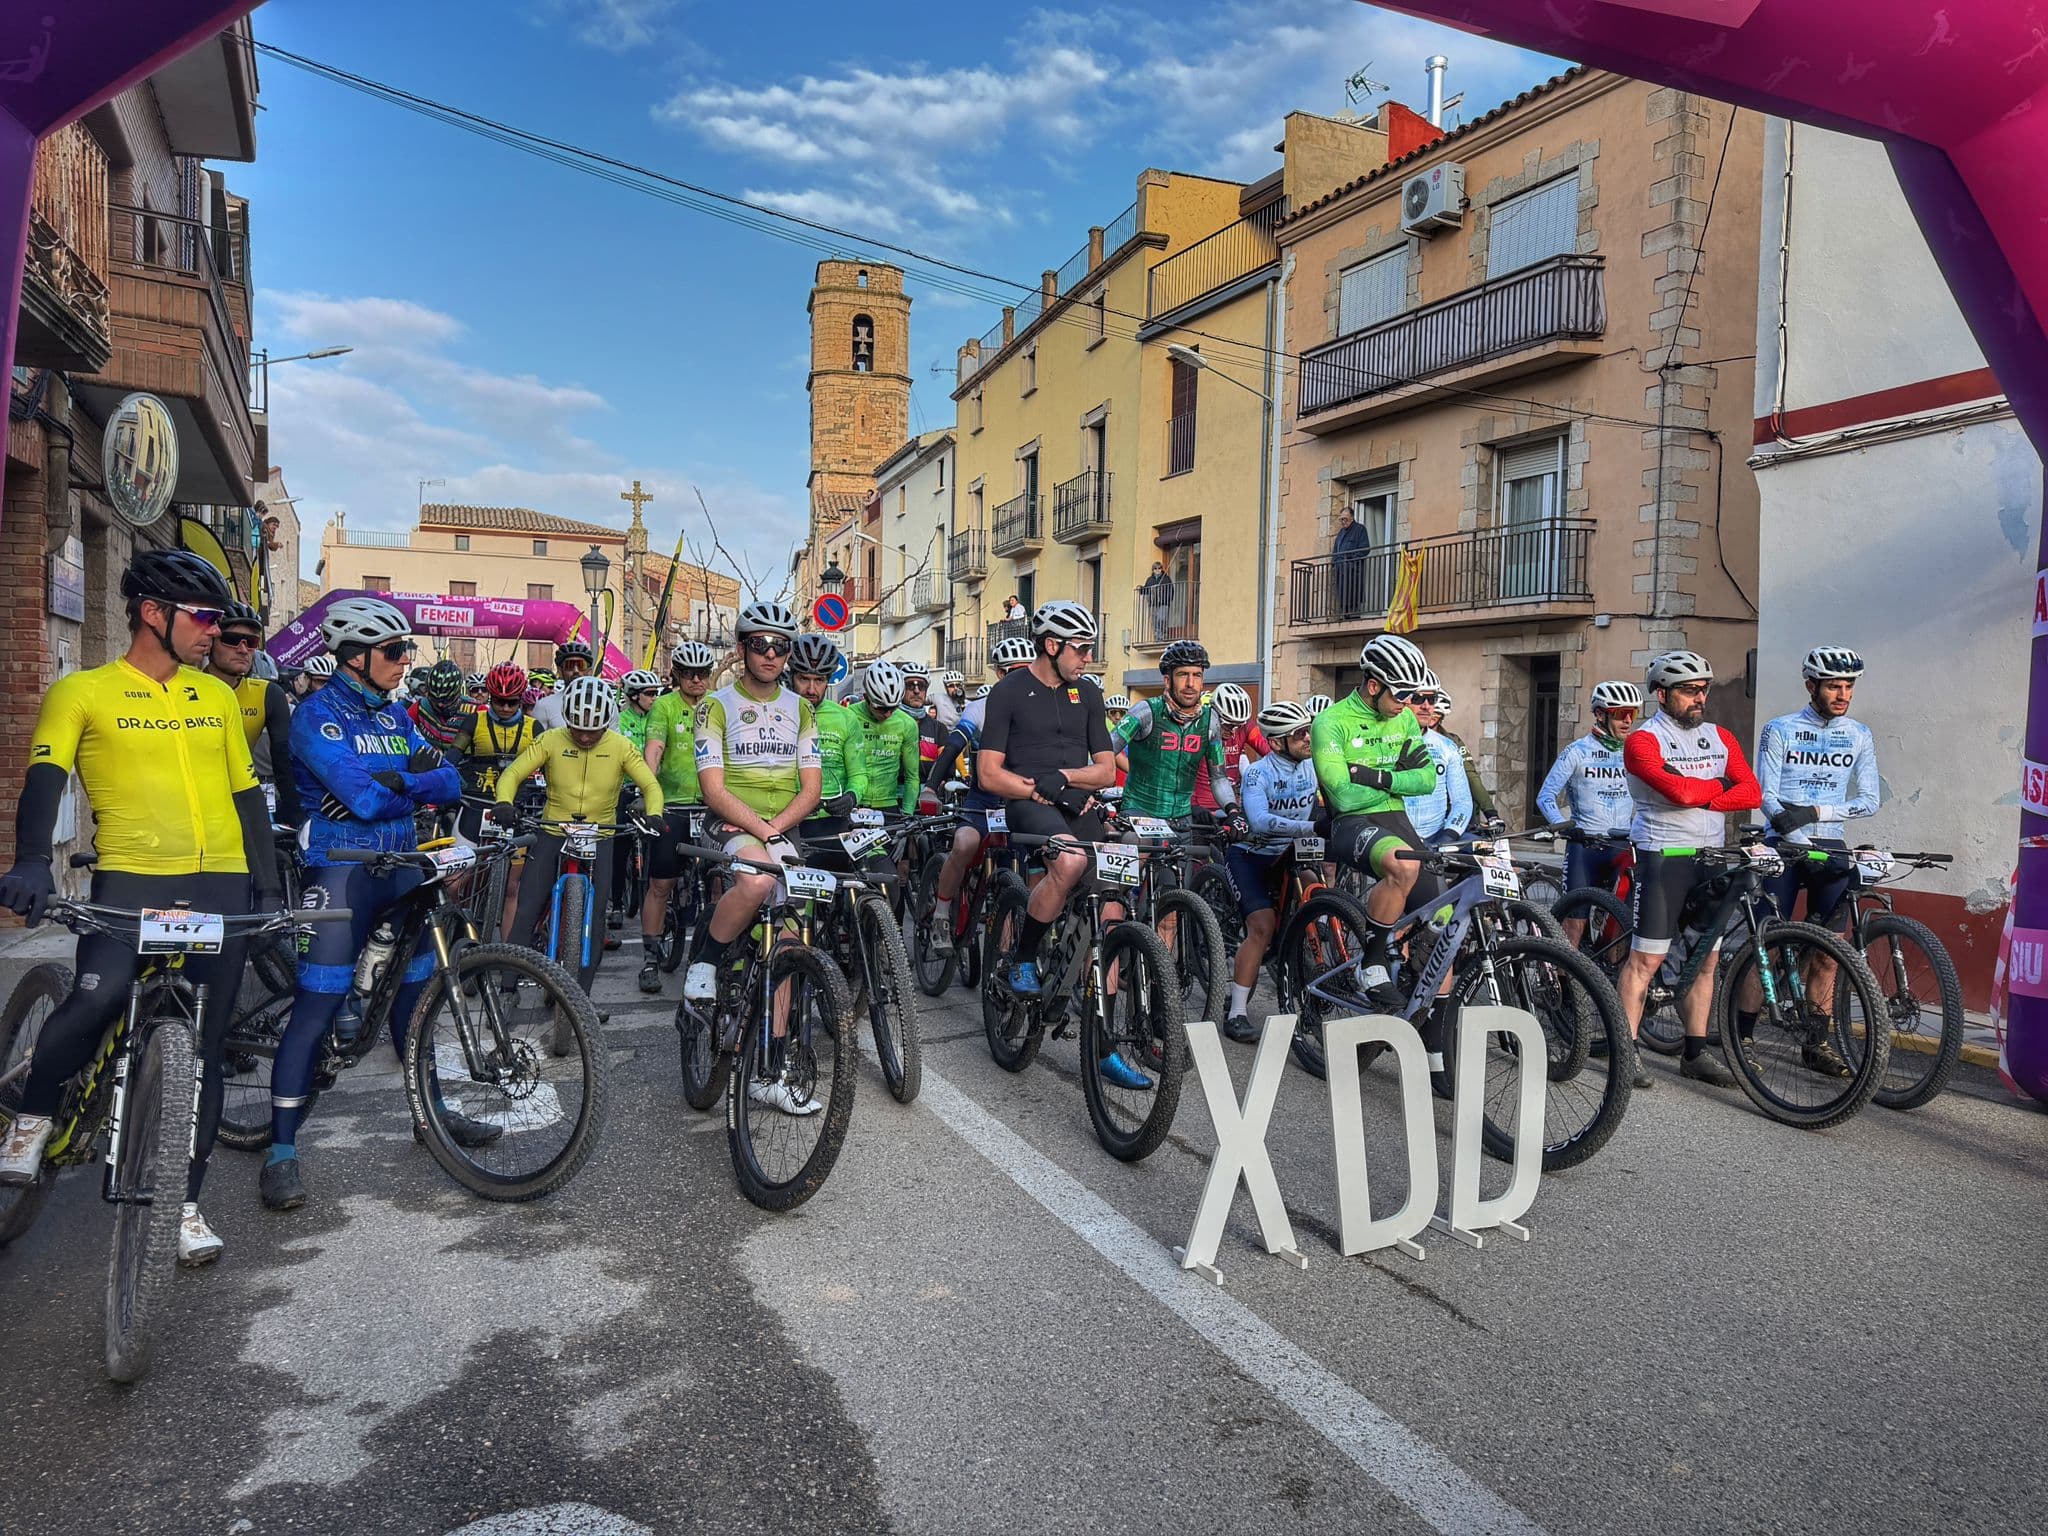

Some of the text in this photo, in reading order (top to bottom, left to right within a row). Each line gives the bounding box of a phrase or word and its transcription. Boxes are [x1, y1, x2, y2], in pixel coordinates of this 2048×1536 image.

[1432, 182, 1441, 191] LG
[124, 690, 152, 699] GOBIK
[116, 715, 224, 730] DRAGO BIKES
[1376, 754, 1400, 765] FRAG
[1785, 750, 1854, 768] HINACO
[1301, 838, 1319, 848] 048
[1106, 854, 1131, 869] 022
[796, 872, 826, 882] 070
[1490, 868, 1511, 882] 044
[160, 923, 205, 934] 147
[1414, 919, 1461, 1001] S-WORKS
